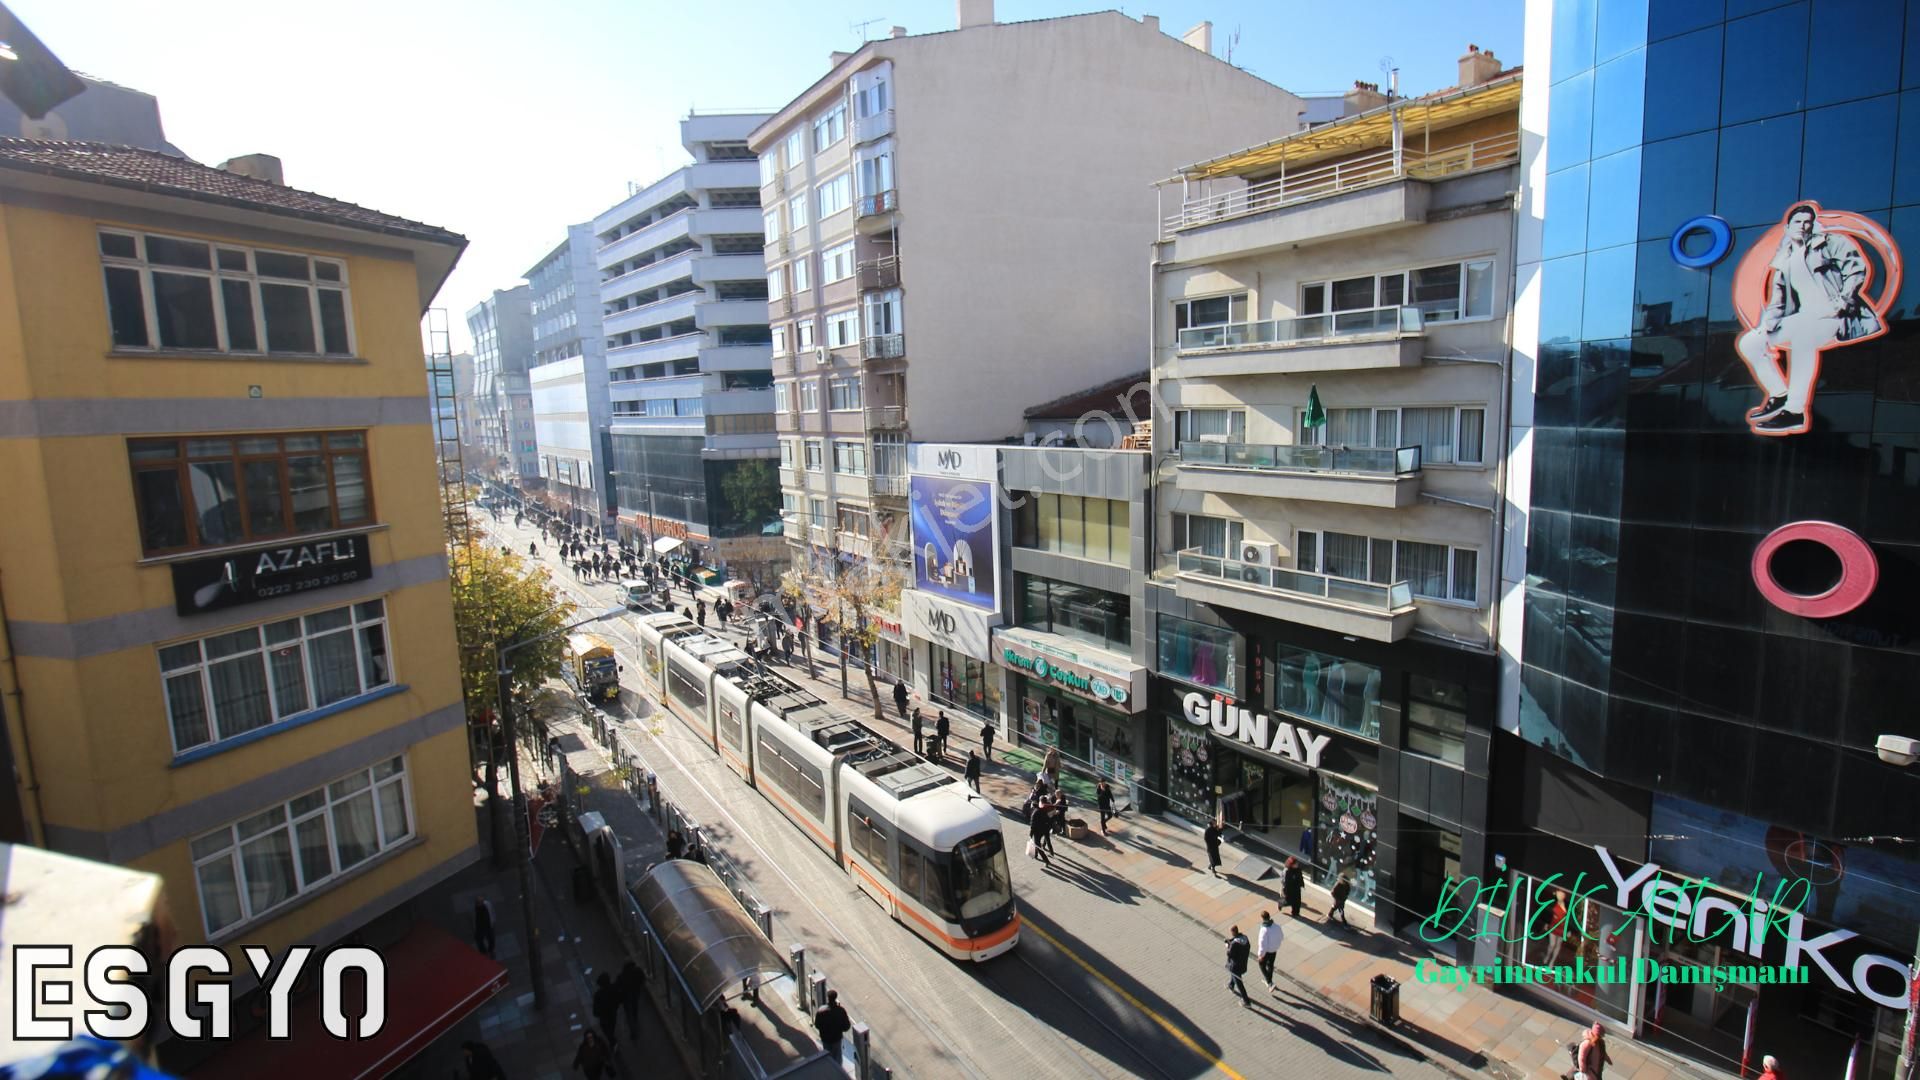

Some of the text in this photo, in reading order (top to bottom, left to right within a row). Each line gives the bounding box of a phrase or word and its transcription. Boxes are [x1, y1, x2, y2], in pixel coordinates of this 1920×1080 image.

[937, 448, 962, 470] MAD
[255, 538, 356, 575] AZAFLI
[928, 608, 956, 635] MAD
[1182, 691, 1332, 769] GÜNAY
